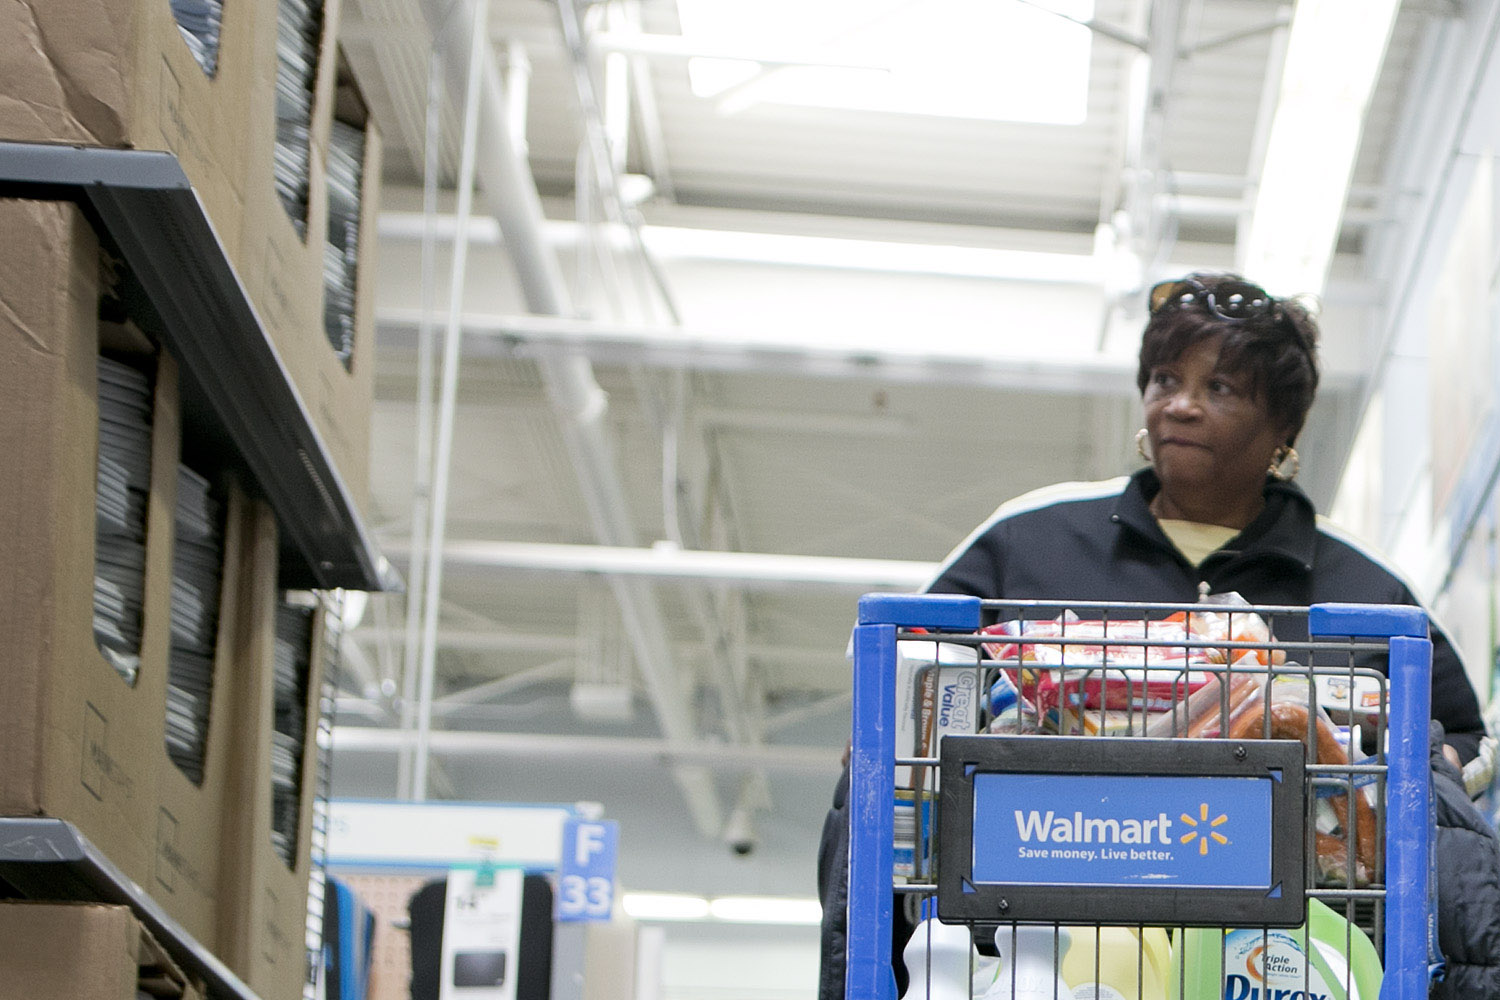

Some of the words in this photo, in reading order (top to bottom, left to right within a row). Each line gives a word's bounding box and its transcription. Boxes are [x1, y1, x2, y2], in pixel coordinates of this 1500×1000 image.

[939, 683, 957, 728] Value
[951, 670, 977, 731] Great
[576, 825, 606, 868] F
[1014, 810, 1172, 845] Walmart
[1018, 847, 1049, 859] Save
[1051, 848, 1098, 862] money.
[1101, 848, 1127, 860] Live
[1130, 849, 1174, 861] better.
[561, 874, 612, 914] 33
[1265, 963, 1298, 974] Action
